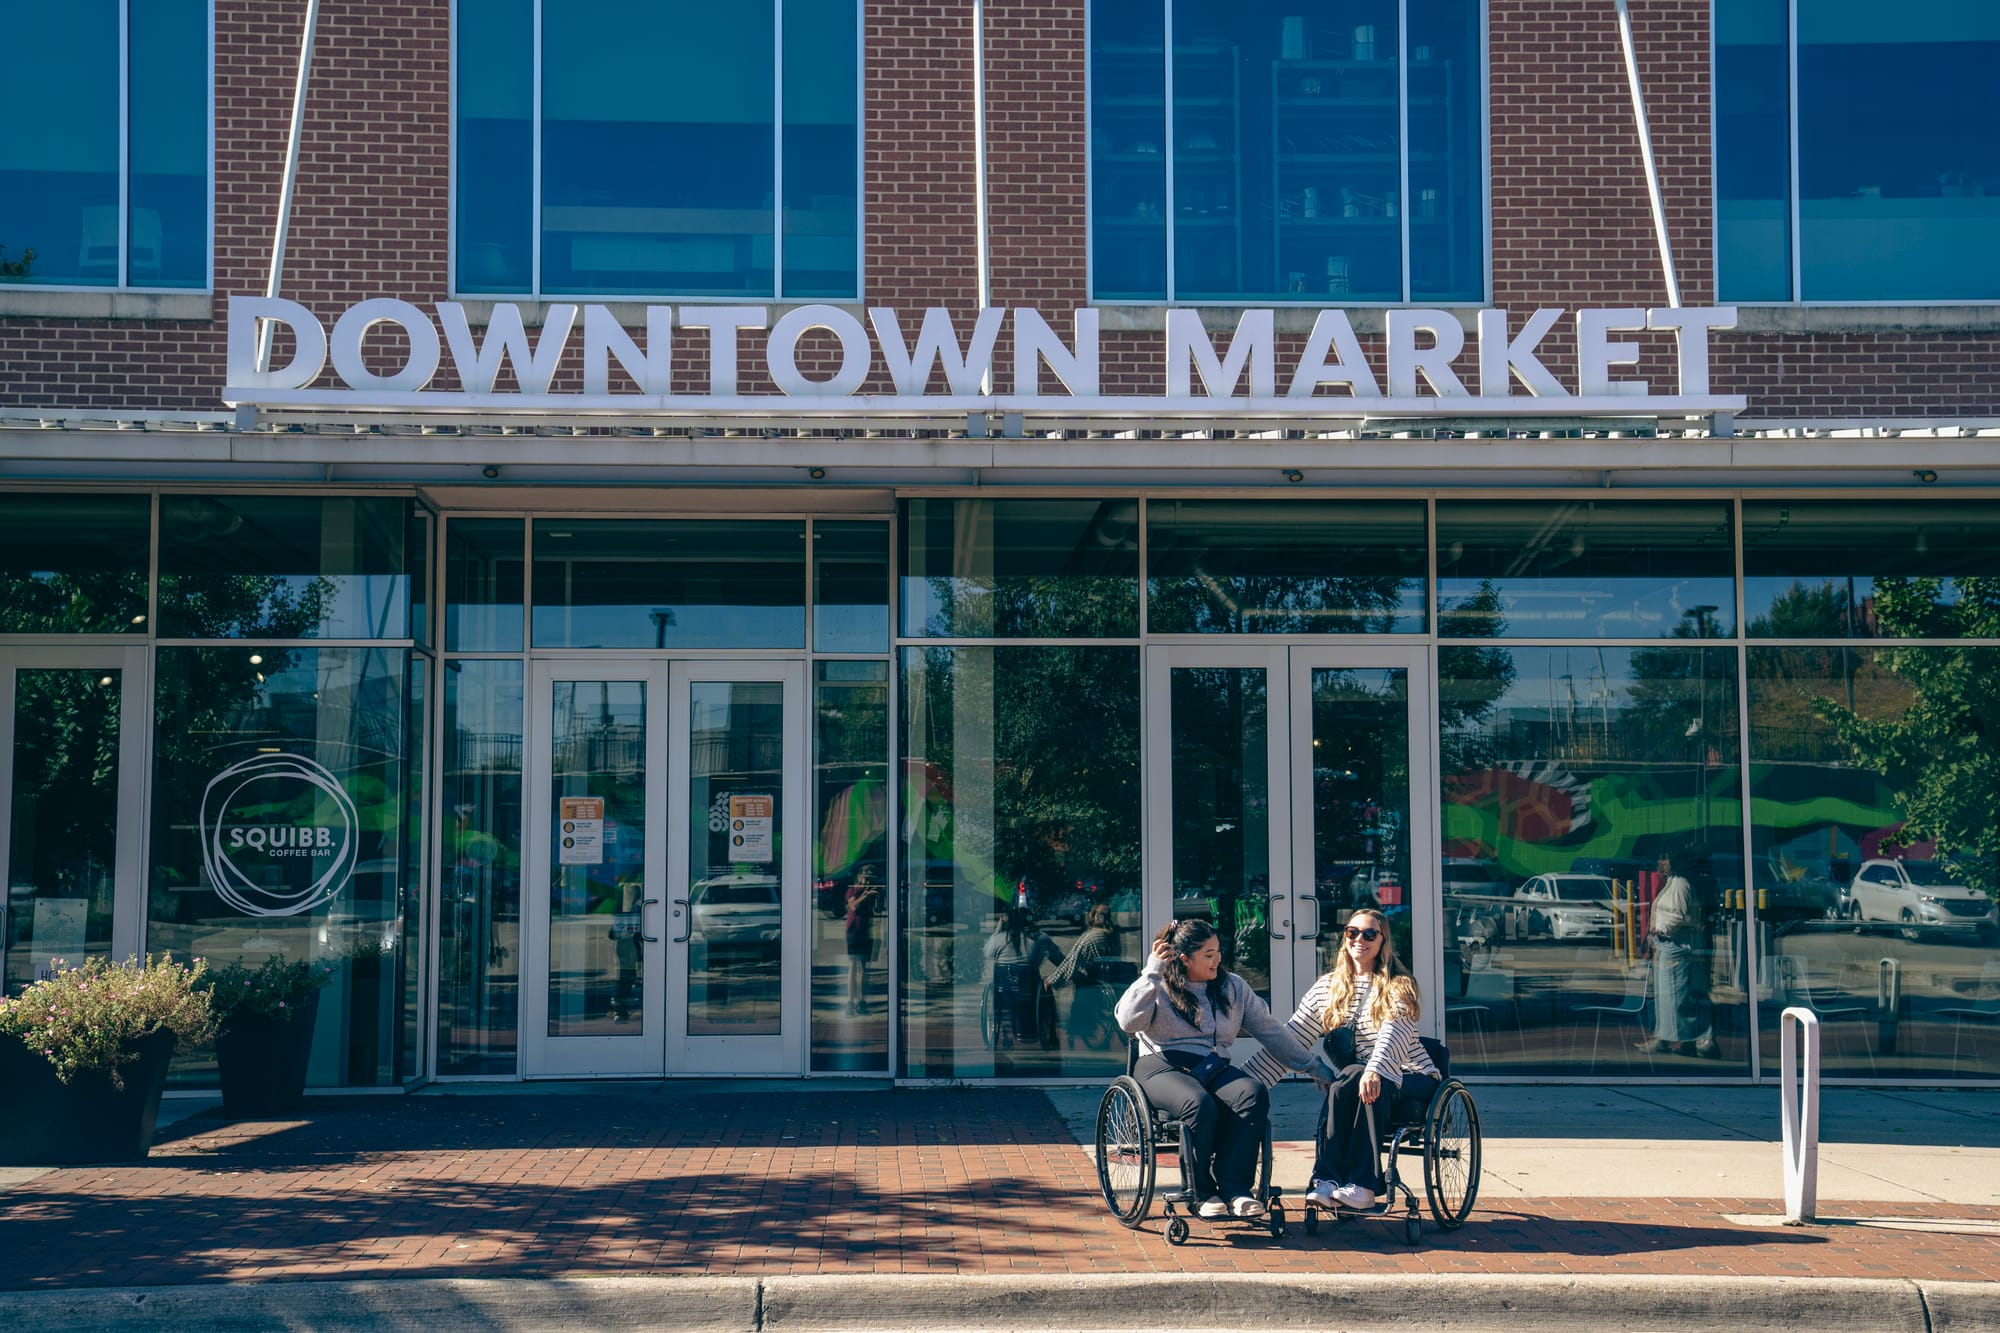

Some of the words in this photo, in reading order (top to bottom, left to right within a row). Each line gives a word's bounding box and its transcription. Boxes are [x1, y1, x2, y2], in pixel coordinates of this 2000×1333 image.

[227, 296, 1100, 398] DOWNTOWN
[1166, 306, 1738, 398] MARKET
[230, 827, 336, 852] SQUIBB.
[269, 849, 308, 857] COFFEE
[311, 849, 331, 857] BAR
